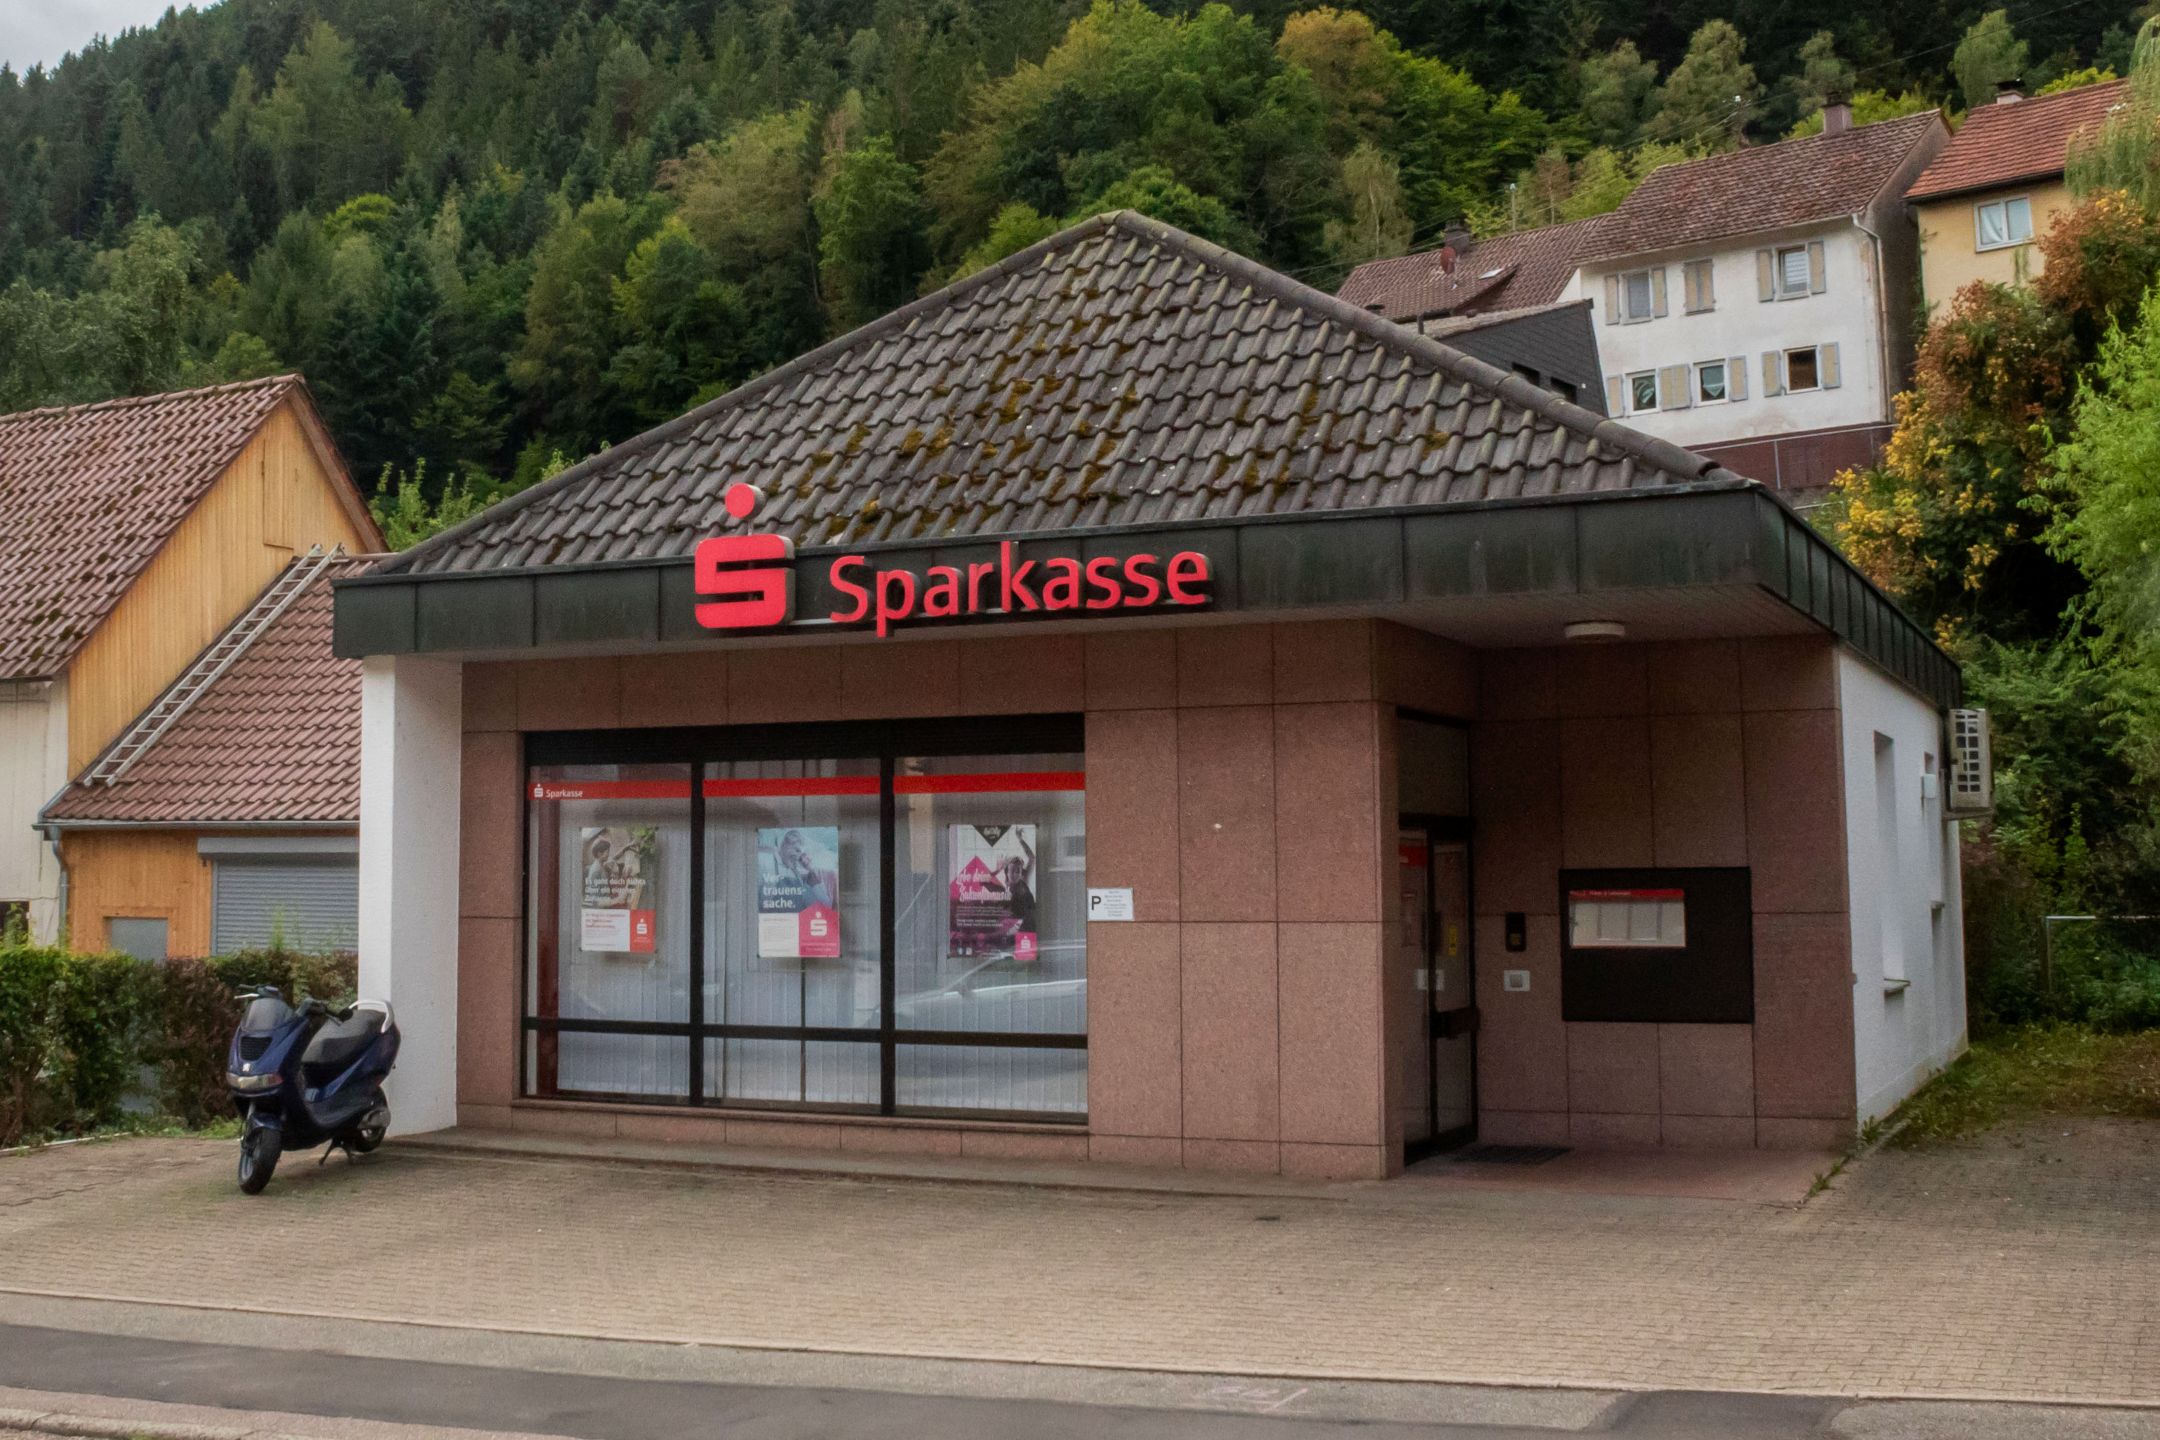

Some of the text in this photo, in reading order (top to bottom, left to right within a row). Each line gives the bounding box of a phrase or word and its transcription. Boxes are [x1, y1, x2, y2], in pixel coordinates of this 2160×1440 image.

[829, 540, 1212, 638] Sparkasse
[545, 789, 584, 799] Sparkasse
[763, 885, 807, 896] trauens-
[762, 896, 796, 908] sache.
[1091, 895, 1102, 911] P
